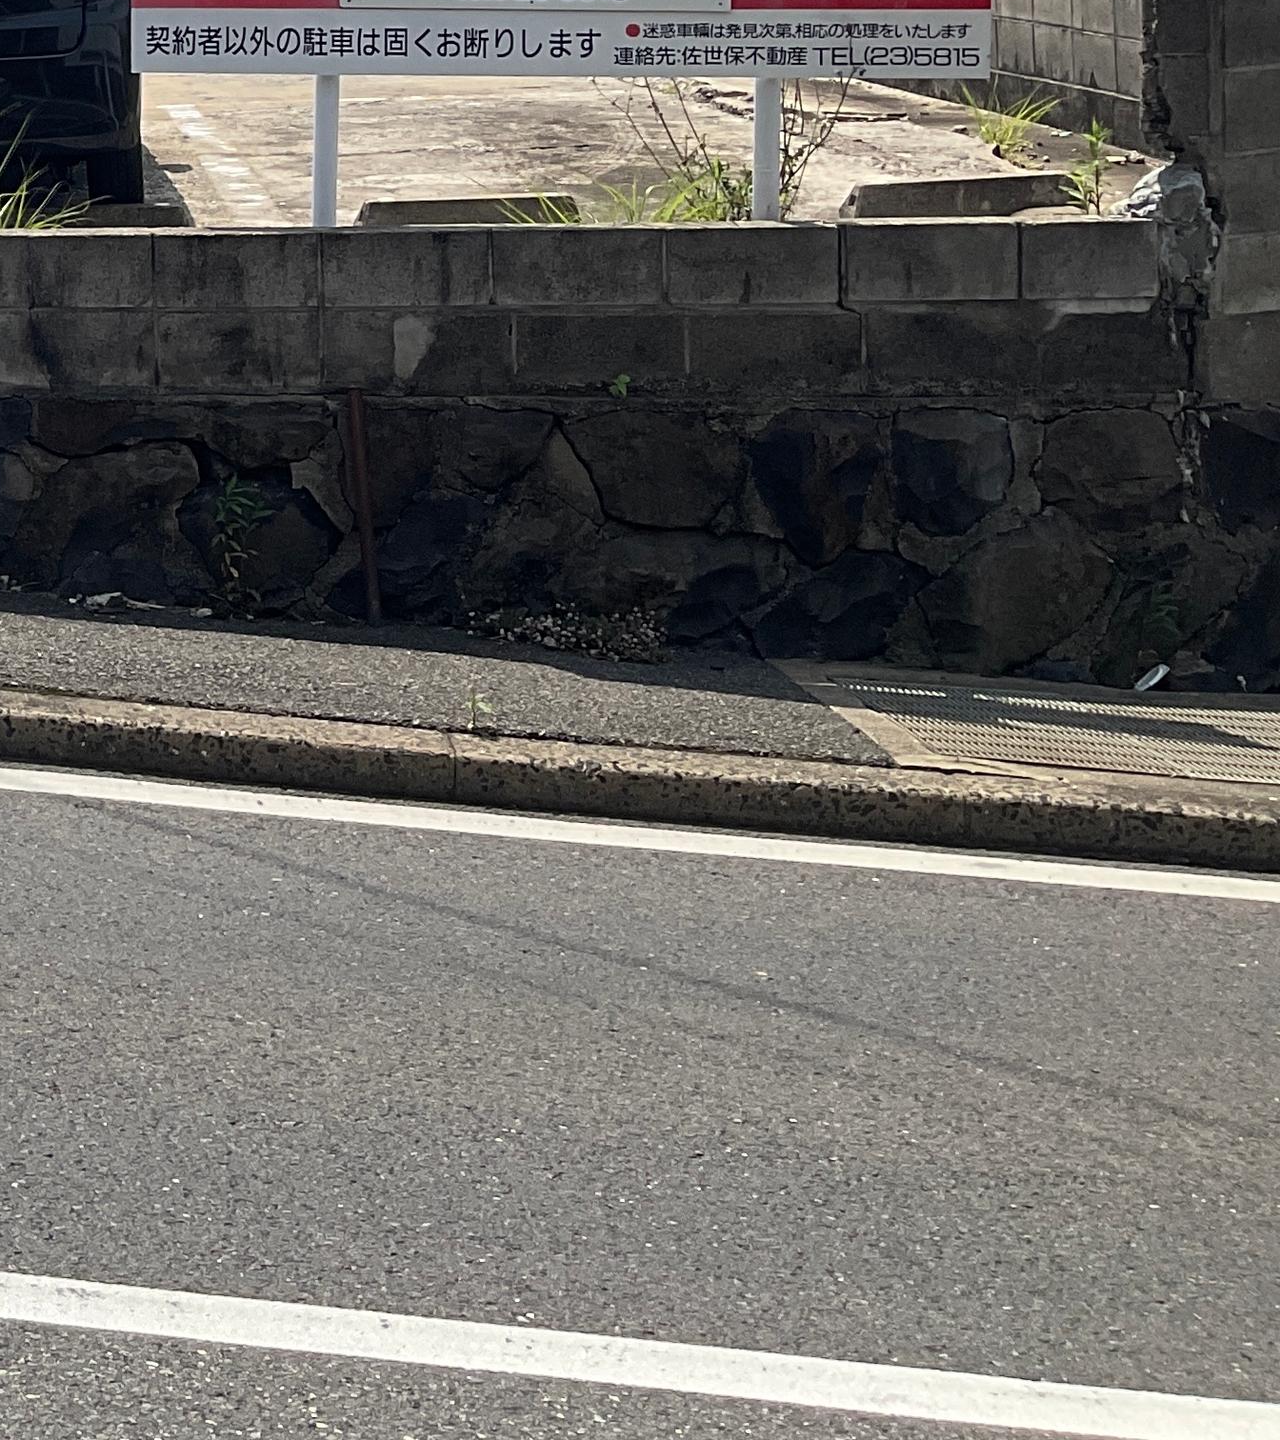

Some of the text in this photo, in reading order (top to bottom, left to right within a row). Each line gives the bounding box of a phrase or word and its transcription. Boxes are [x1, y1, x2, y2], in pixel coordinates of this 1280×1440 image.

[145, 25, 602, 59] 契約者以外の駐車は固くお断りします
[812, 46, 980, 67] TEL(23)5815
